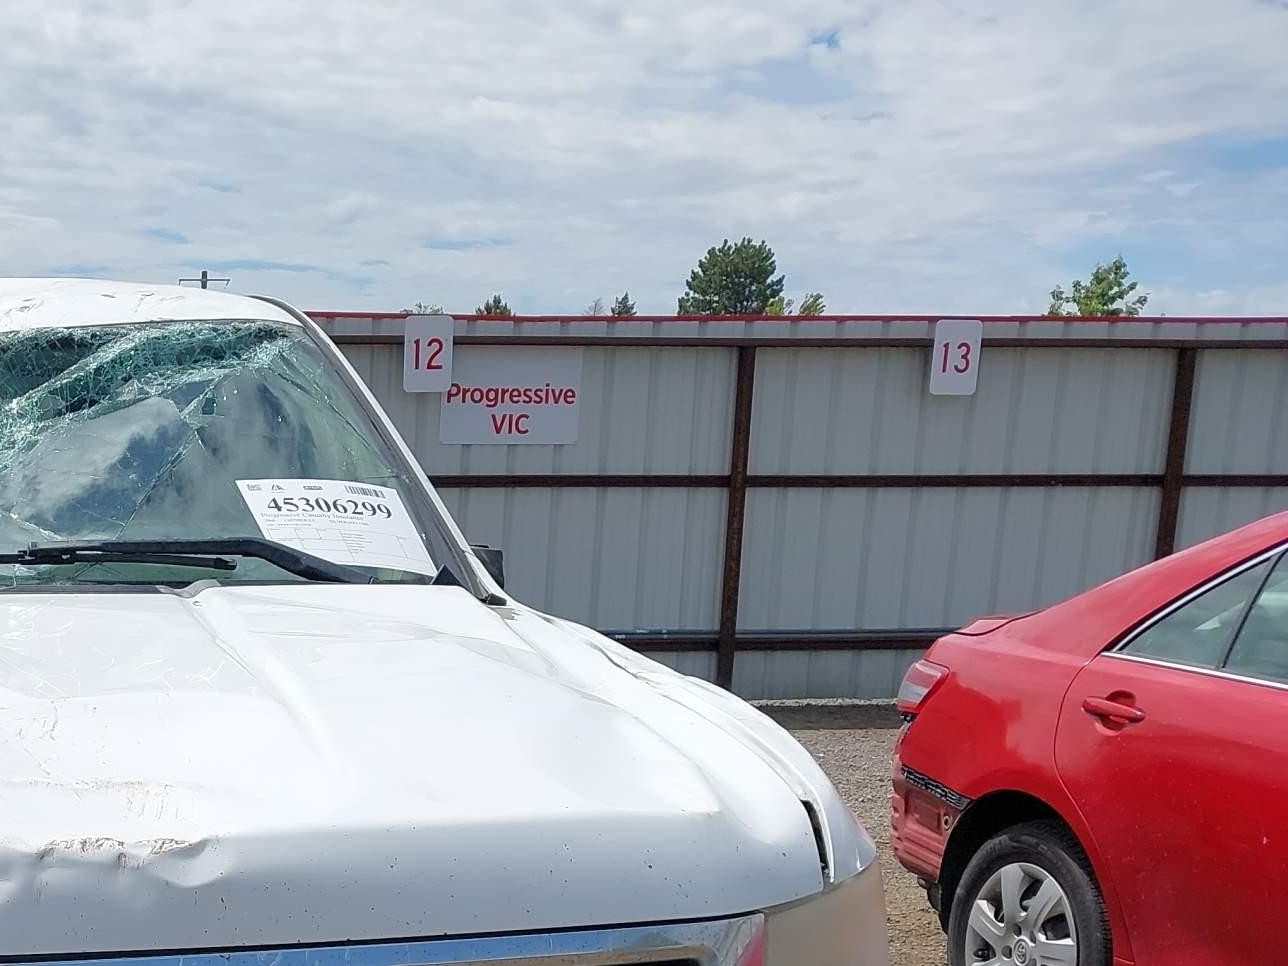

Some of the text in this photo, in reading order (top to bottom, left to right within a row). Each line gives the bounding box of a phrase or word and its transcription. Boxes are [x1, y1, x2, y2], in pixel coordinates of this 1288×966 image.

[413, 338, 444, 370] 12
[941, 342, 971, 374] 13
[446, 383, 577, 408] Progressive
[491, 413, 530, 435] VIC
[267, 496, 392, 519] 45306299
